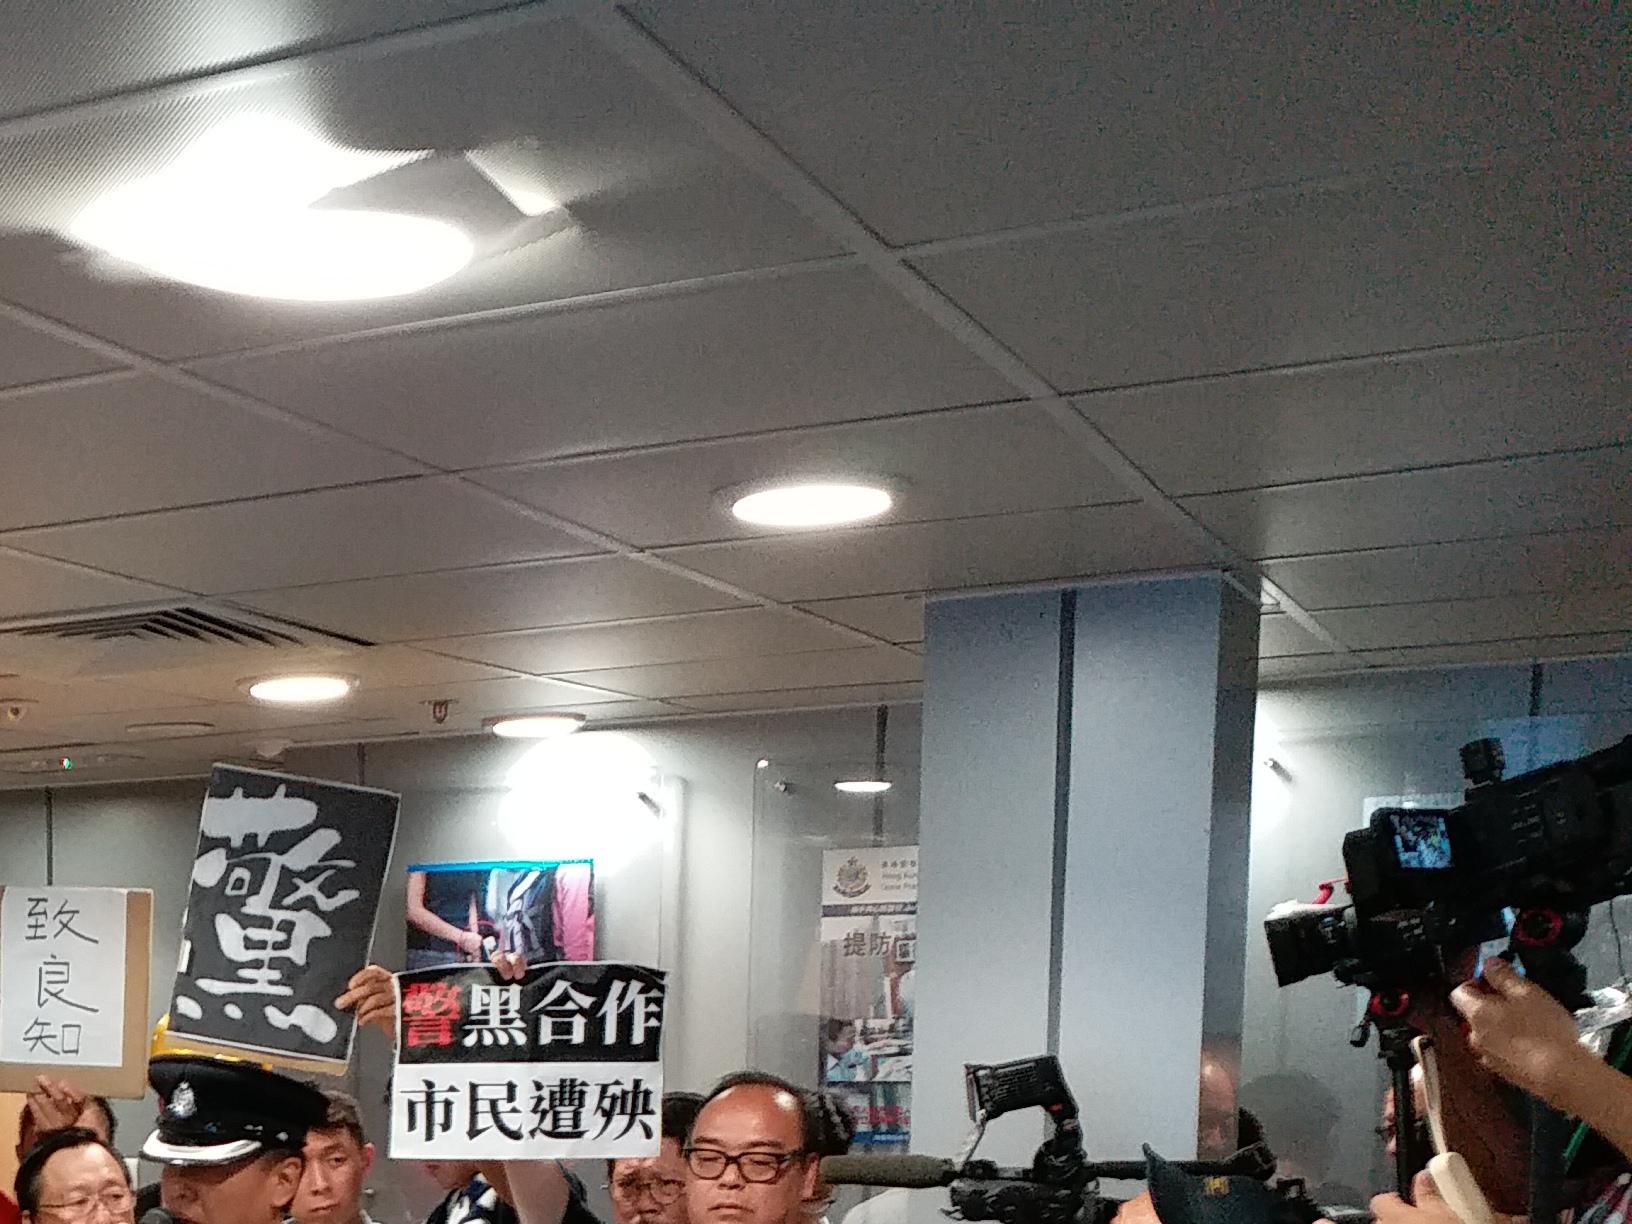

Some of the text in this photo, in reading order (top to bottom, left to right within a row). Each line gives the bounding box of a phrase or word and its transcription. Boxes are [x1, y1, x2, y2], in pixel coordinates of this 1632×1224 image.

[23, 897, 99, 1056] 致良知
[402, 977, 664, 1047] 警黑合作
[399, 1077, 657, 1143] 市民遭殃
